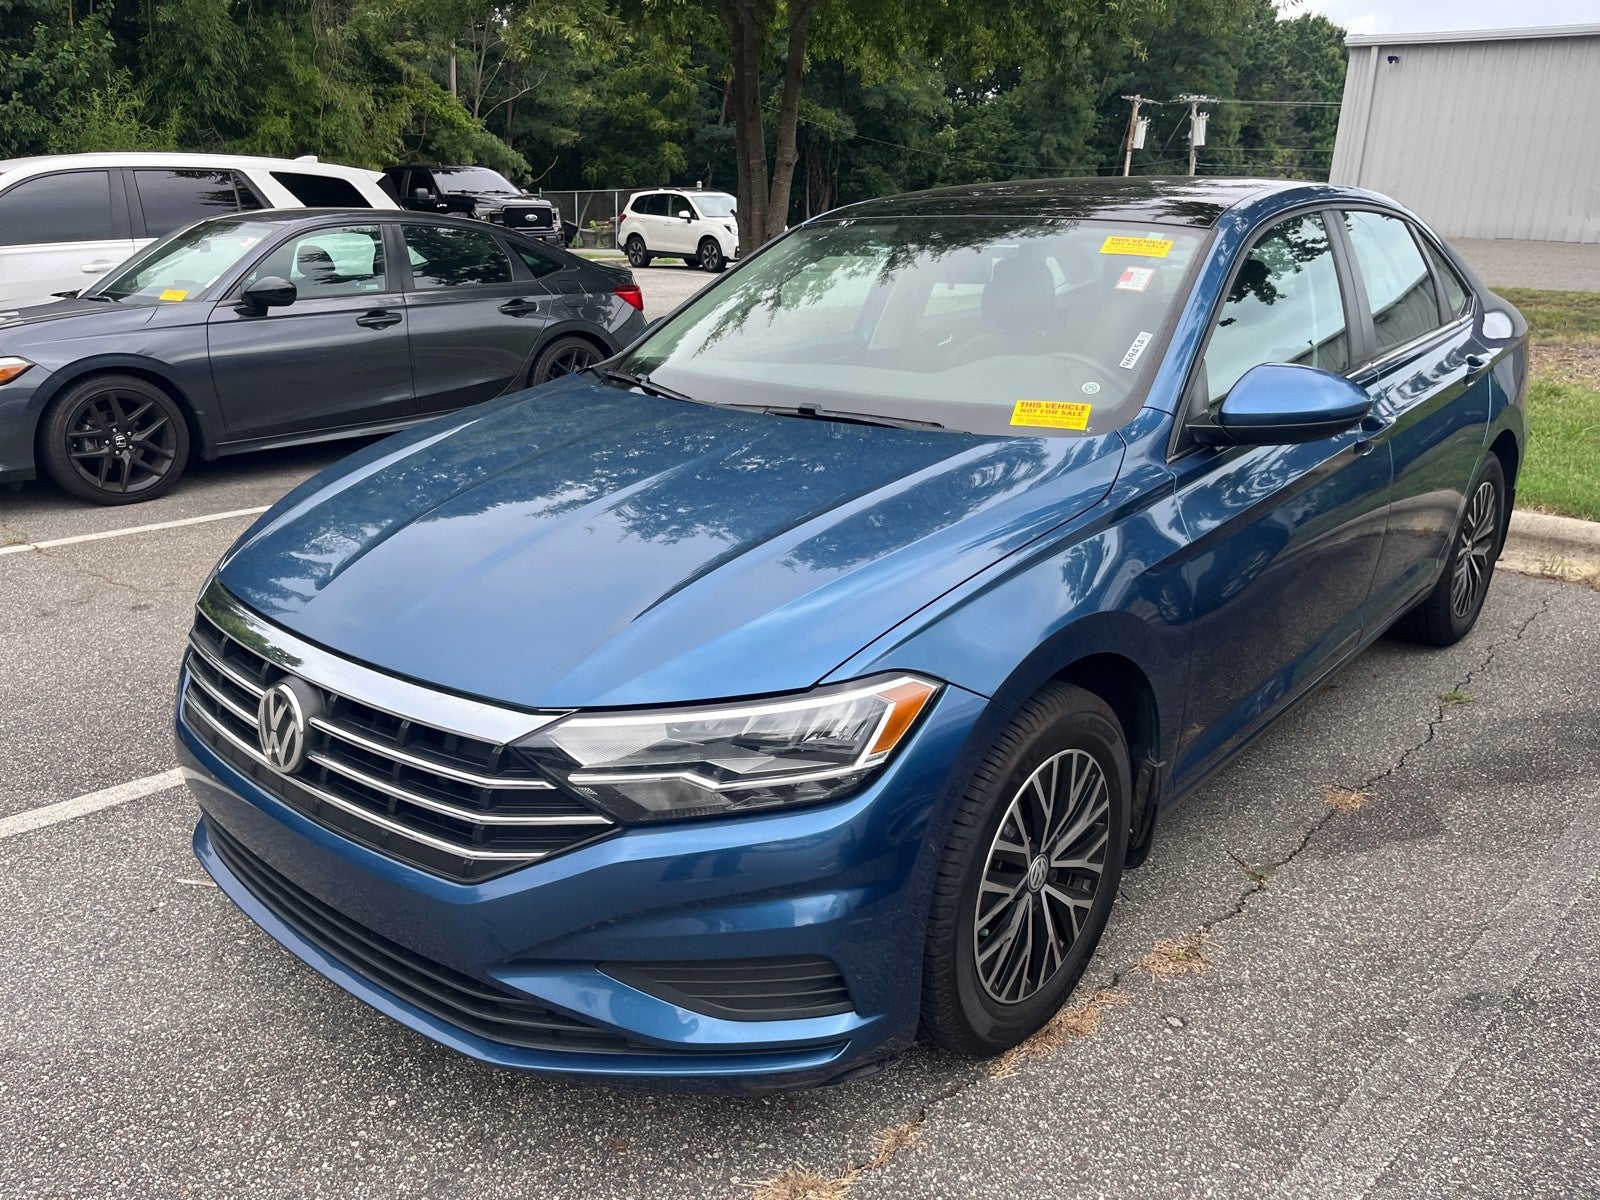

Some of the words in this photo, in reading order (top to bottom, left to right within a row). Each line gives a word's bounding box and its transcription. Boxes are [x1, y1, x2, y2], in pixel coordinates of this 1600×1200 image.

[1132, 238, 1169, 246] VEHICLE
[1122, 339, 1146, 367] 96945A
[1020, 401, 1042, 409] THIS
[1045, 402, 1088, 412] VEHICLE
